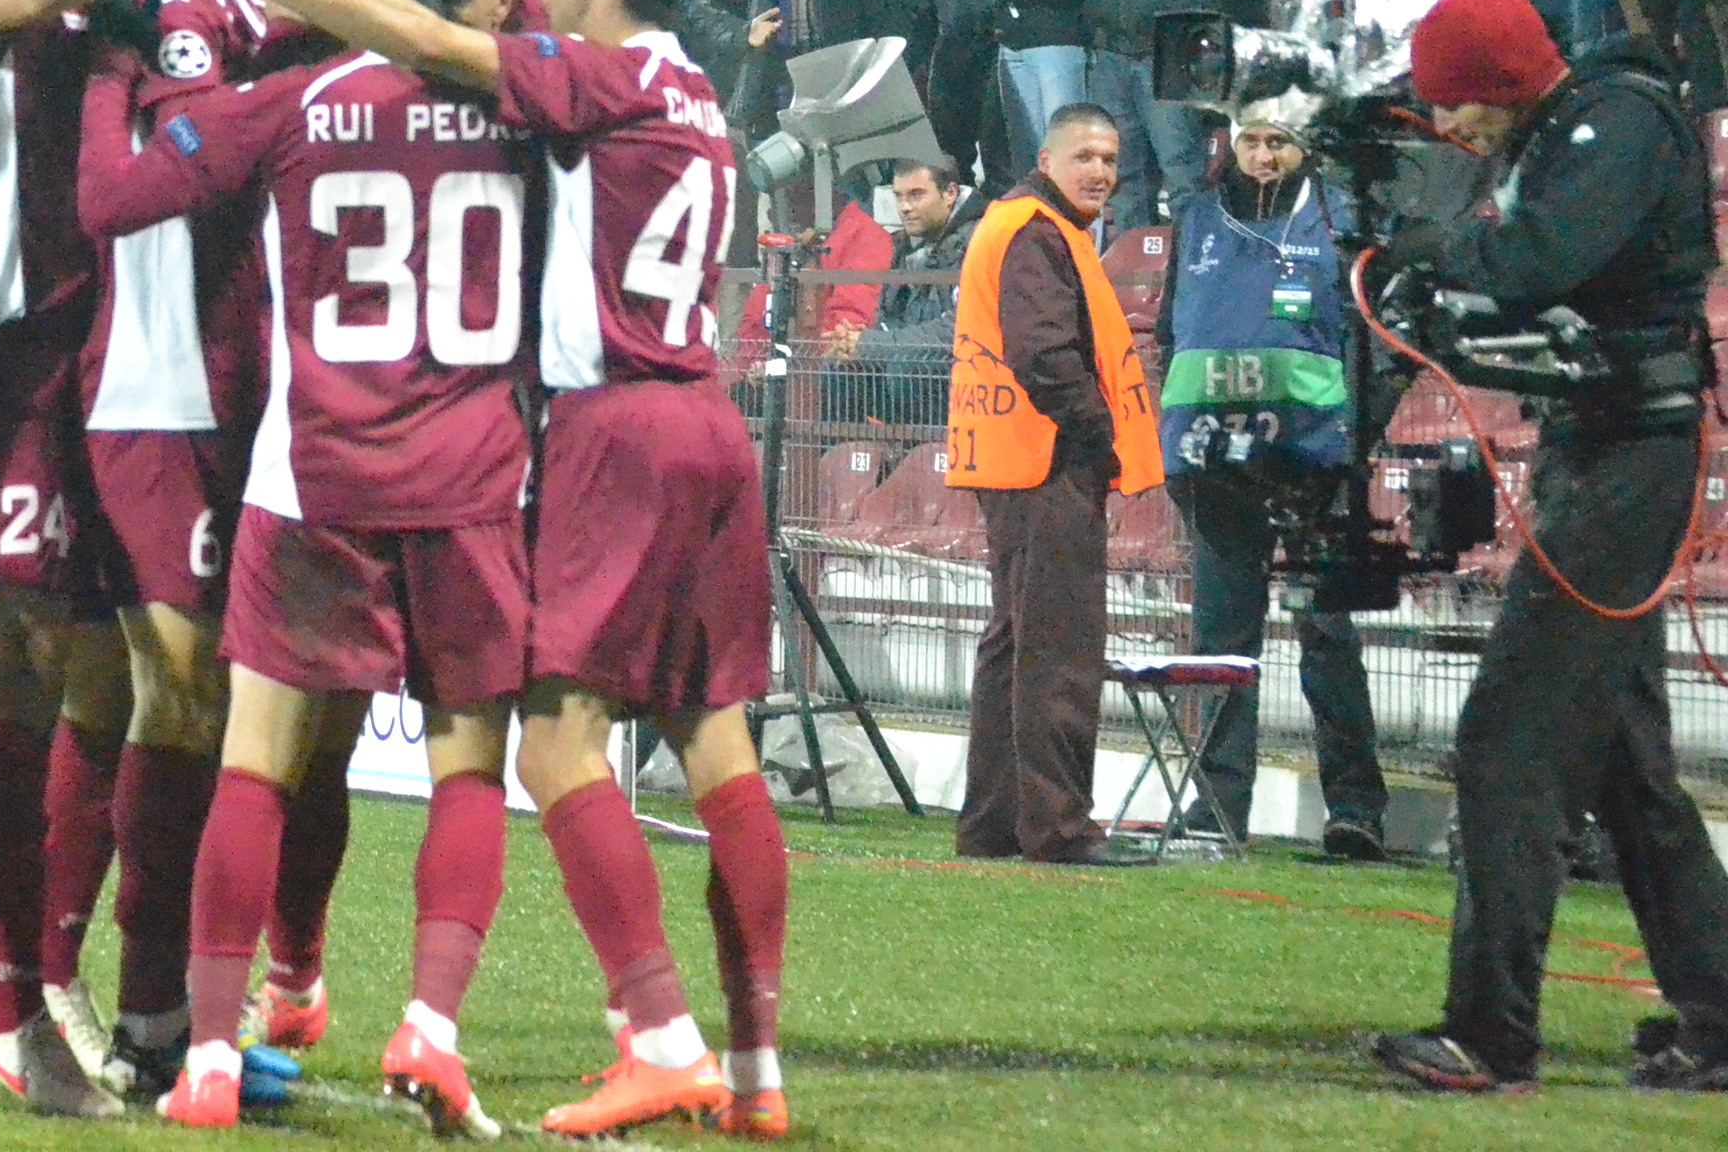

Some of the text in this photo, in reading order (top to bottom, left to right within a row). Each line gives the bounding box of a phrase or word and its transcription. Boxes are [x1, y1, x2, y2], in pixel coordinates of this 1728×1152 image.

[307, 103, 374, 143] RUI
[310, 170, 525, 366] 30
[1206, 356, 1264, 397] HB
[189, 508, 222, 578] 6
